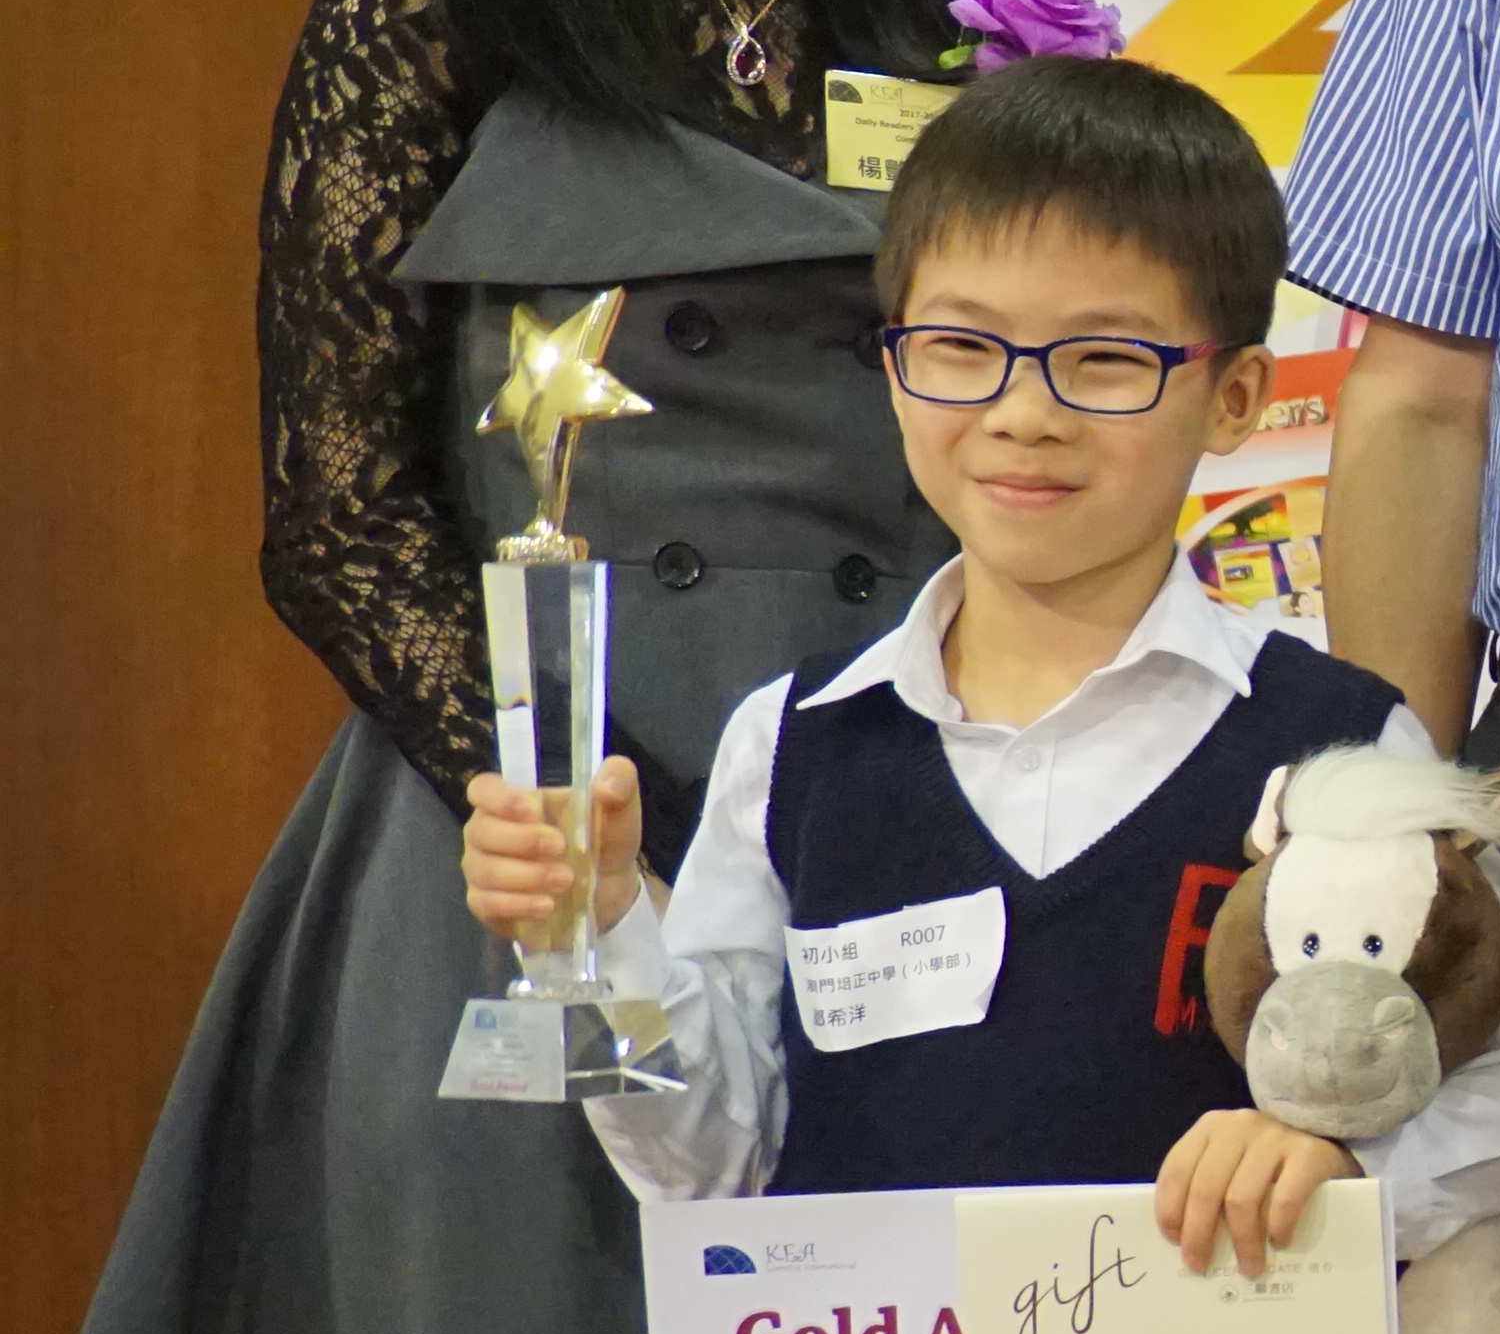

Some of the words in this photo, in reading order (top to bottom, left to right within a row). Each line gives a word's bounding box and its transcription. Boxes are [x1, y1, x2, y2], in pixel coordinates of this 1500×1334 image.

[900, 110, 936, 120] 2017-20
[1256, 395, 1330, 431] ers
[900, 925, 946, 947] R007
